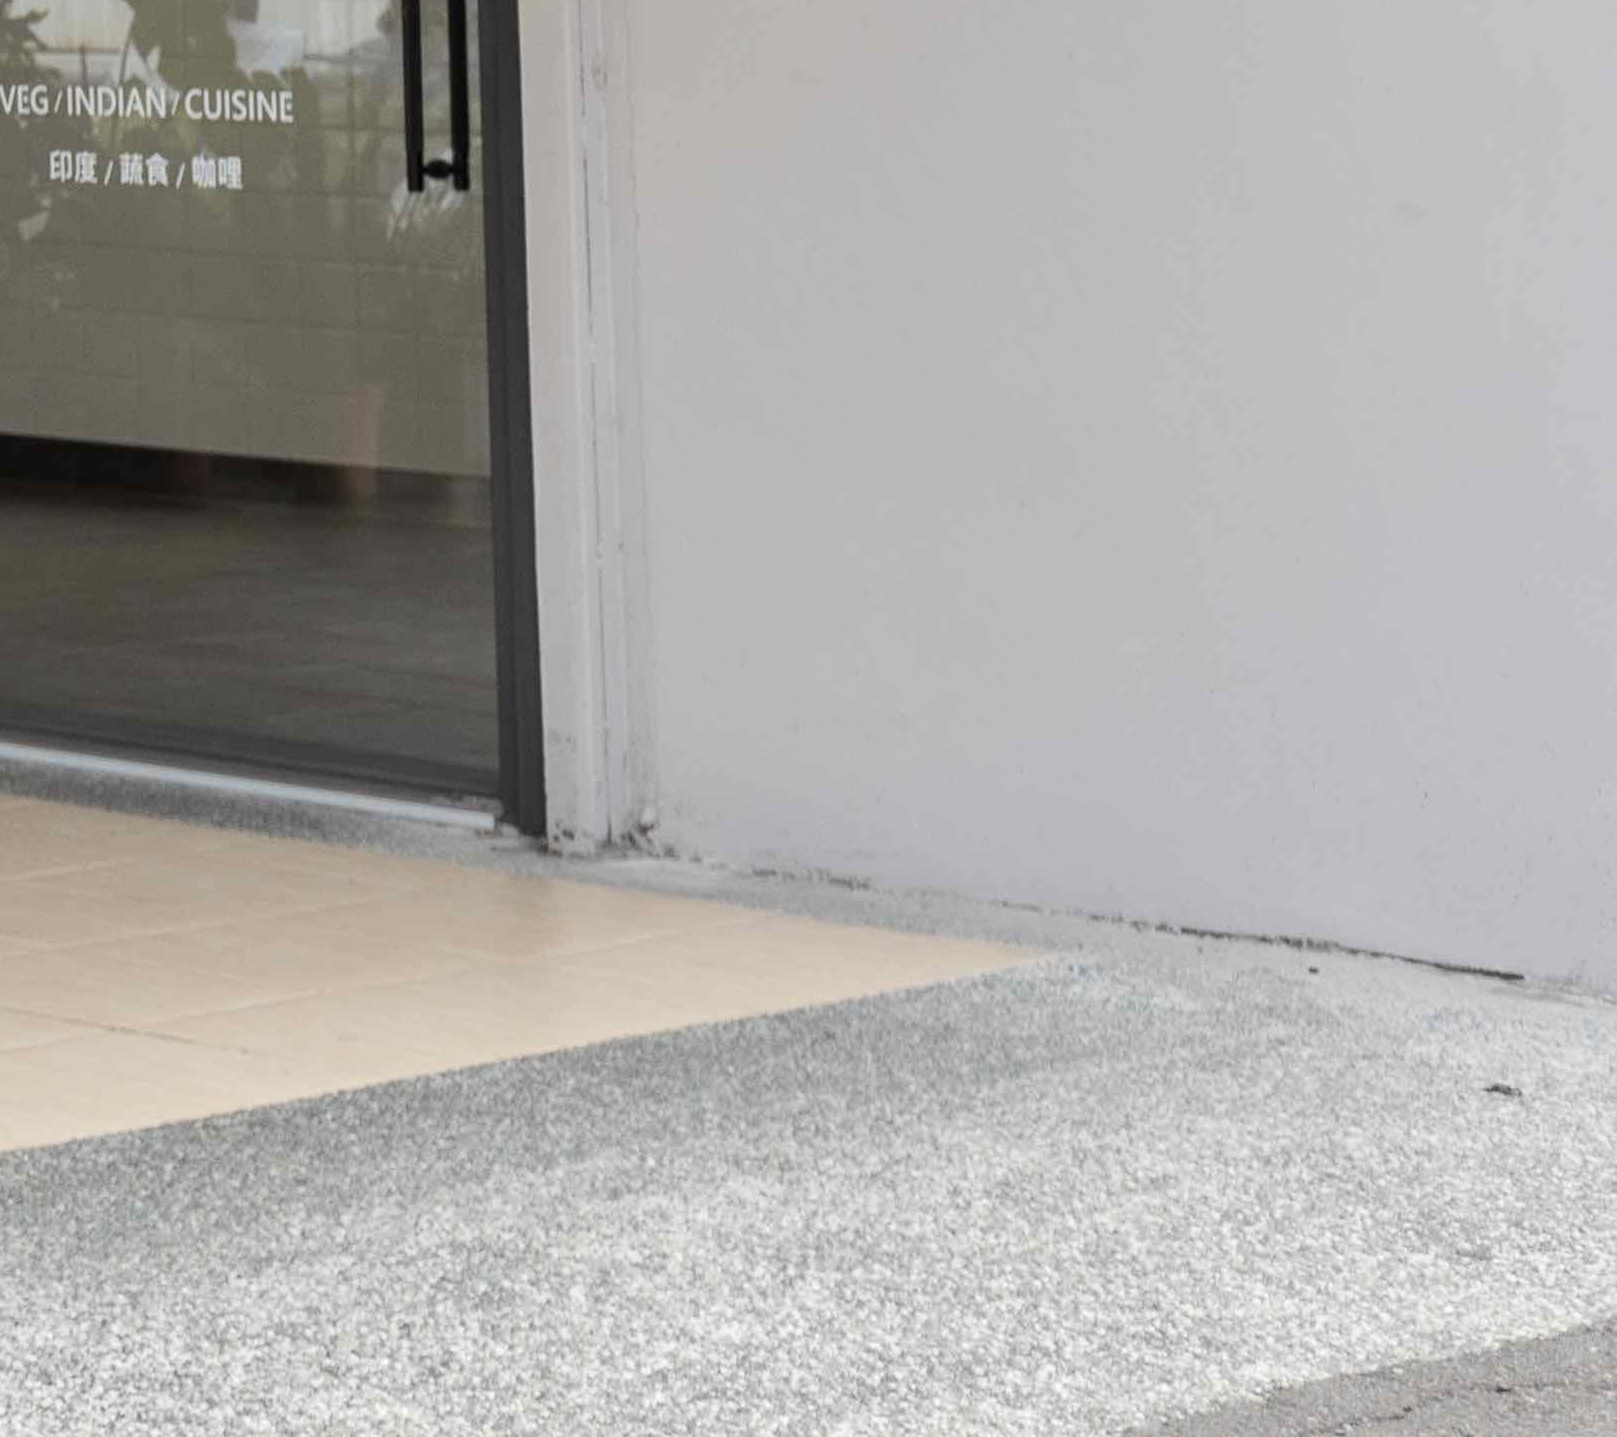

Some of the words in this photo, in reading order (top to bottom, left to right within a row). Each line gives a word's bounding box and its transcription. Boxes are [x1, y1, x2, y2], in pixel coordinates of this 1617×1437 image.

[66, 86, 167, 118] INDIAN
[184, 88, 294, 123] CUISINE
[49, 149, 98, 184] 印度
[191, 153, 243, 190] 咖哩
